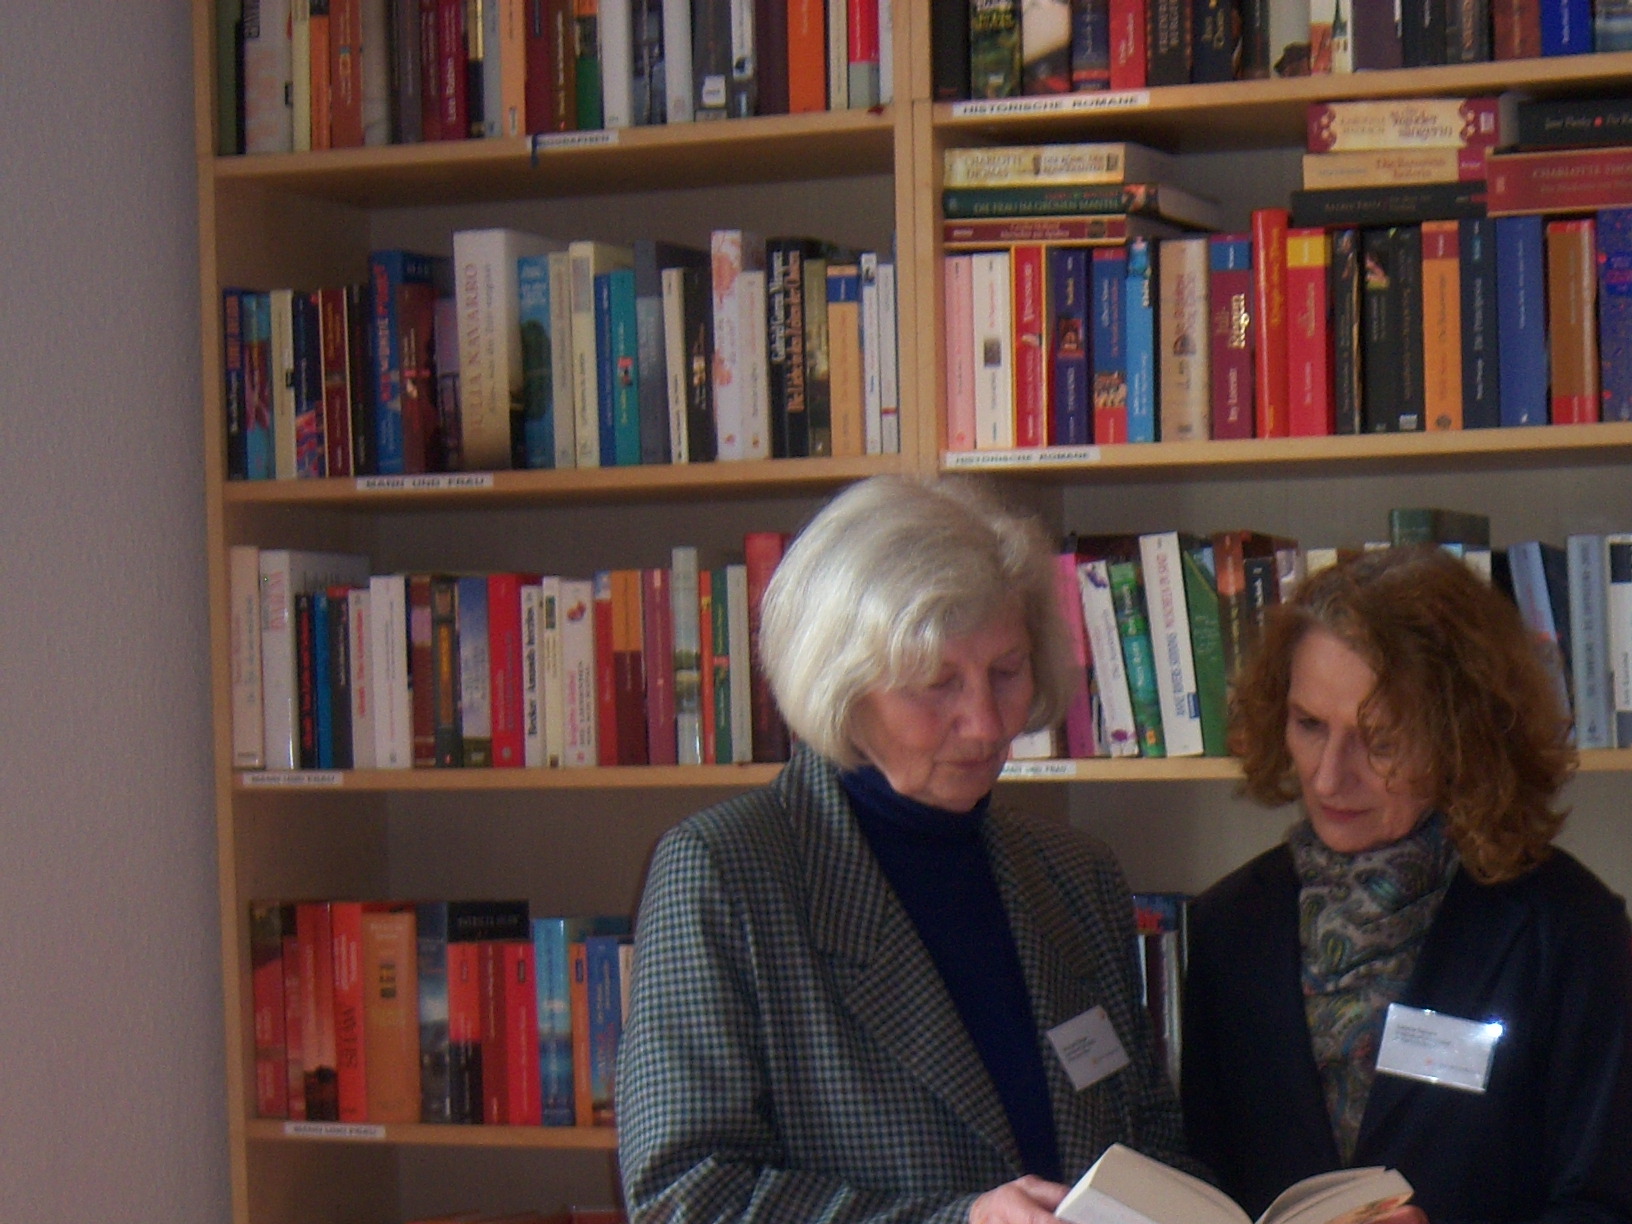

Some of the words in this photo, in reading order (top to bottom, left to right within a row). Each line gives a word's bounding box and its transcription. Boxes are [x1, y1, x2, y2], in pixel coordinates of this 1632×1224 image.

[963, 101, 1062, 115] HISTORISCHE
[1073, 96, 1138, 109] ROMANE
[535, 134, 610, 148] IOGRAFIEN
[463, 263, 481, 366] NAVARRO
[956, 454, 1033, 464] HISTORISCHE
[1040, 451, 1090, 461] ROMANE
[366, 480, 404, 488] MANN
[412, 479, 440, 487] UND
[448, 477, 484, 486] FRAU
[251, 775, 280, 784] MANN
[283, 775, 305, 784] UND
[307, 775, 335, 783] FRAU
[294, 1126, 322, 1135] MANN
[324, 1126, 347, 1136] UND
[349, 1127, 377, 1137] FRAU
